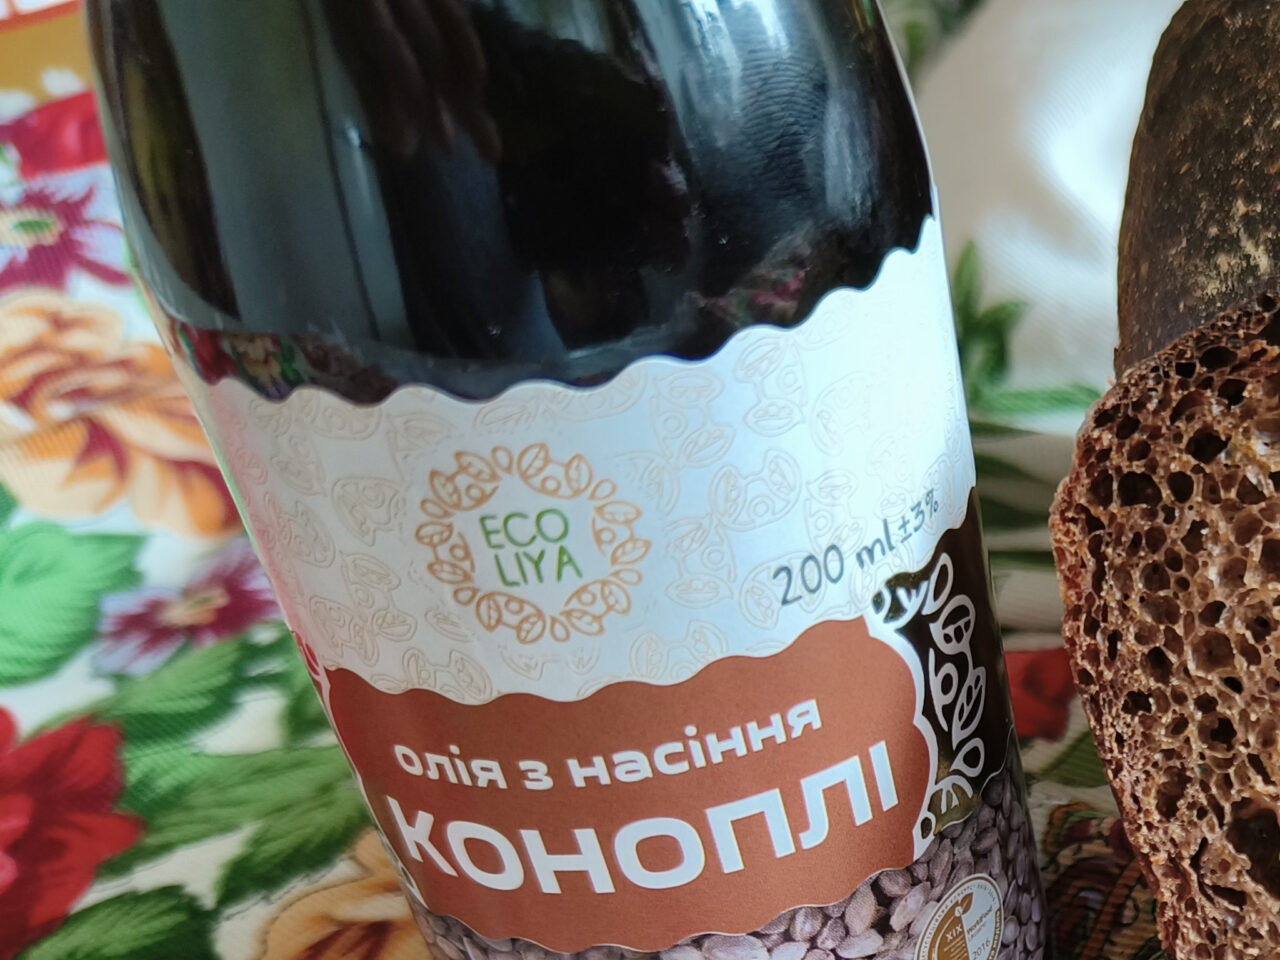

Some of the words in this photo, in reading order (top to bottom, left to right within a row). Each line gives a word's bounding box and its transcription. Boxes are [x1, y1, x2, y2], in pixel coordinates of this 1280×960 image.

[479, 508, 569, 550] ECO
[493, 545, 582, 588] LIYA
[773, 545, 844, 605] 200
[855, 520, 895, 571] ml
[394, 744, 506, 790] олія
[519, 760, 554, 791] з
[566, 698, 822, 788] насіння
[386, 740, 899, 895] КОНОПЛІ
[972, 938, 990, 960] 2016
